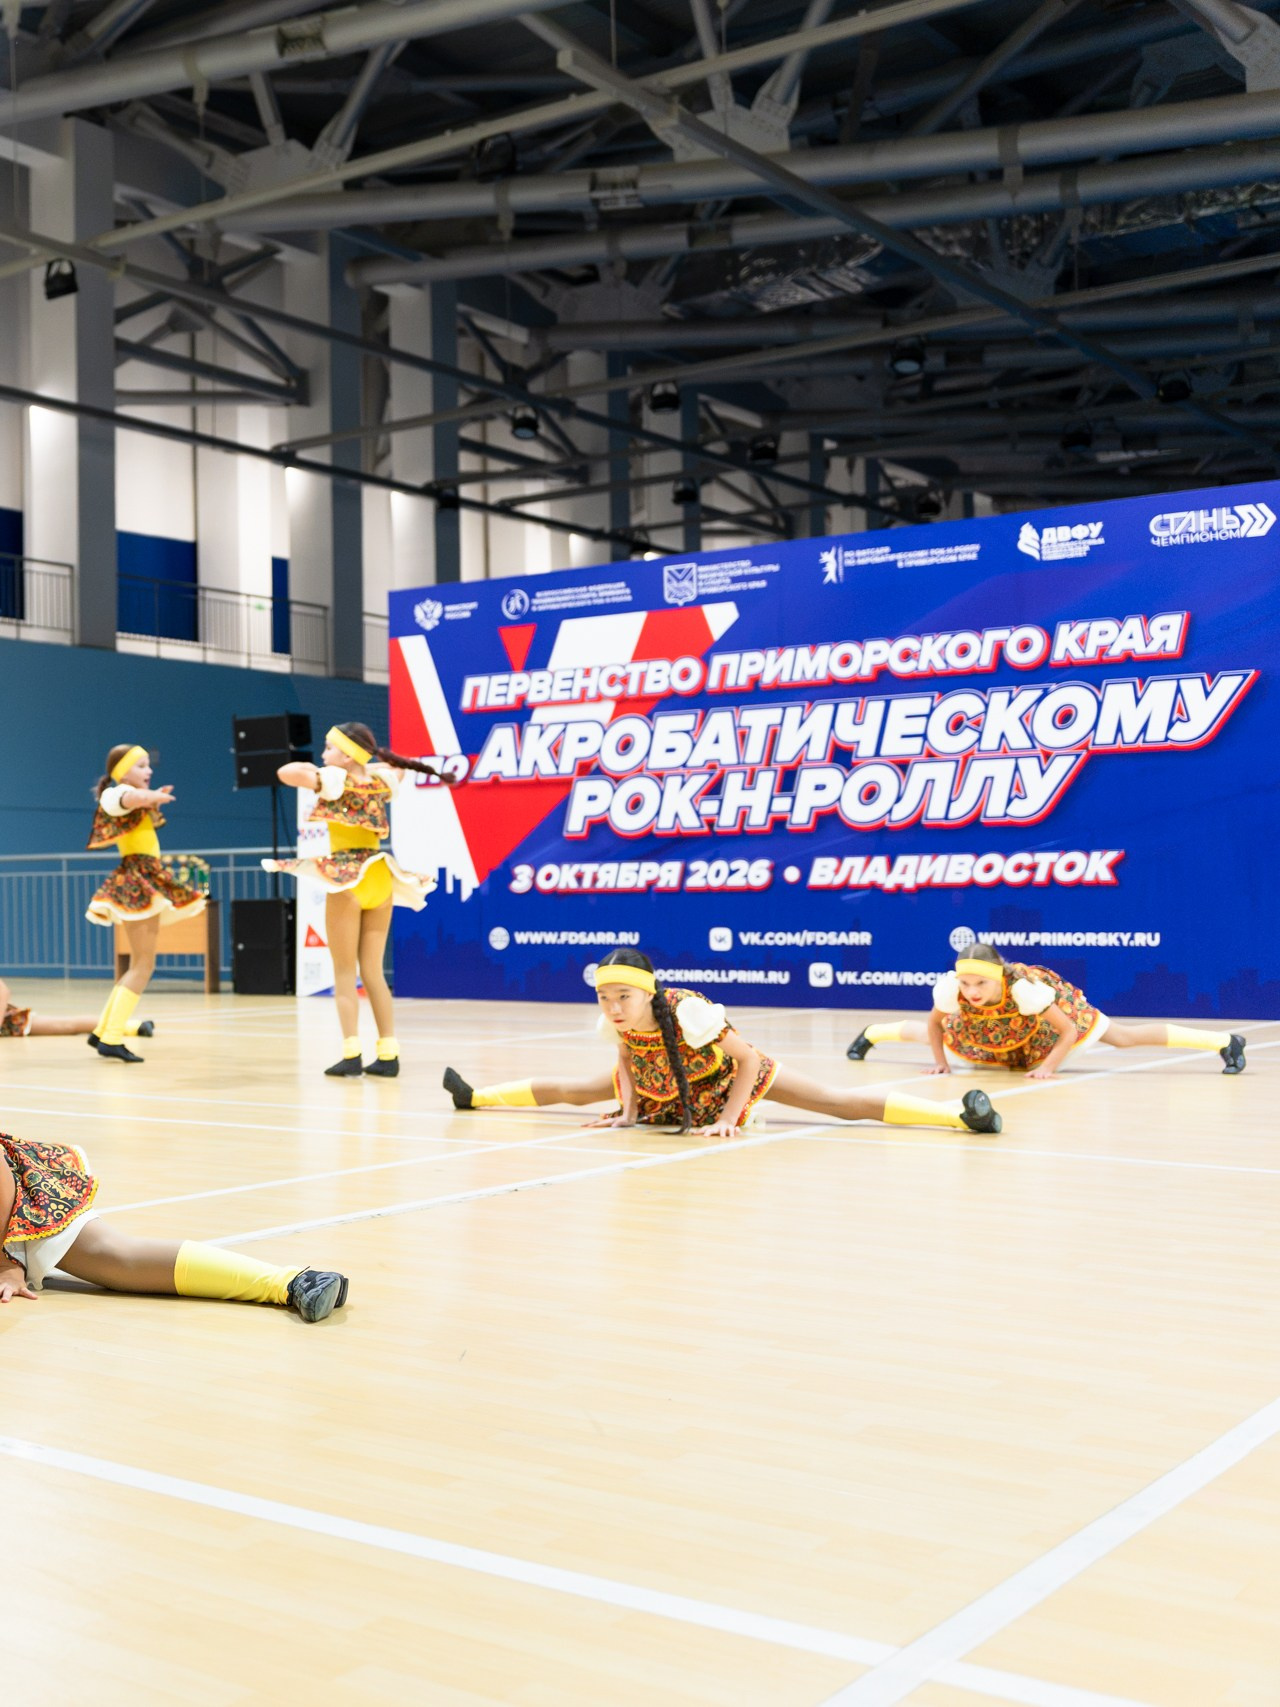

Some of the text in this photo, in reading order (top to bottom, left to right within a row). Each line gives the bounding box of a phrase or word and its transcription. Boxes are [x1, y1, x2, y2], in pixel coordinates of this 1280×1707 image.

[1041, 521, 1104, 543] ДВФУ
[1149, 506, 1241, 537] СТАНЬ
[1151, 528, 1241, 547] ЧЕМПИОНОМ
[461, 611, 1191, 713] ПЕРВЕНСТВО ПРИМОРСКОГО КРАЯ
[469, 669, 1260, 783] АКРОБАТИЧЕСКОМУ
[563, 751, 1087, 840] РОК-Н-РОЛЛУ
[509, 849, 1125, 894] 3 ОКТЯБРЯ 2026 ВЛАДИВОСТОК
[514, 931, 640, 946] WWW.FDSARR.RU
[738, 930, 873, 947] VK.COM/FDSARR
[978, 931, 1161, 947] WWW.PRIMORSKY.RU
[654, 968, 790, 985] OCKNROLLPRIM.RU
